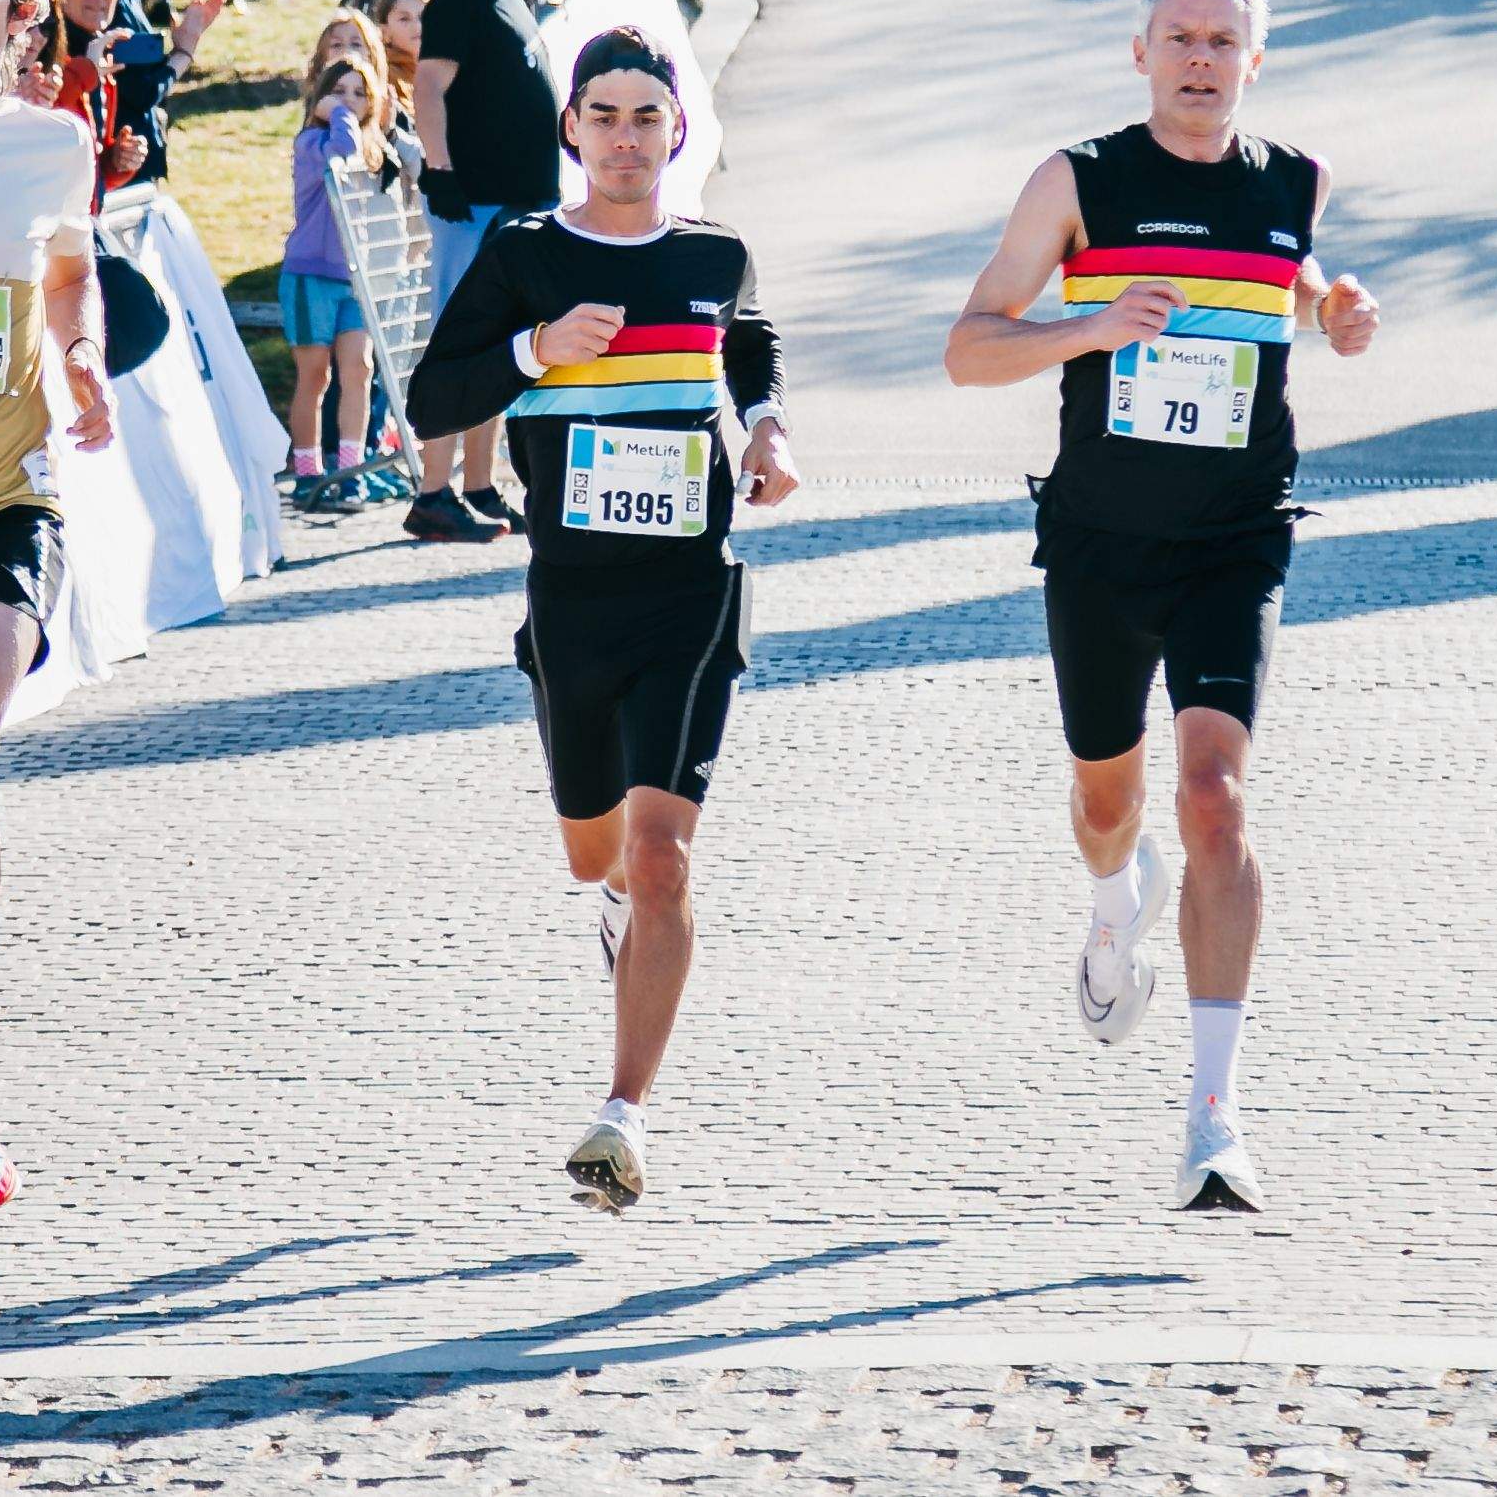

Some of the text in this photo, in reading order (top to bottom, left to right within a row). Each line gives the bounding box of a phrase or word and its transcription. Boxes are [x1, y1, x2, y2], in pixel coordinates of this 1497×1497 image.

[1171, 351, 1228, 367] MetLife
[1164, 400, 1199, 435] 79
[626, 443, 681, 457] MetLife
[599, 490, 674, 526] 1395
